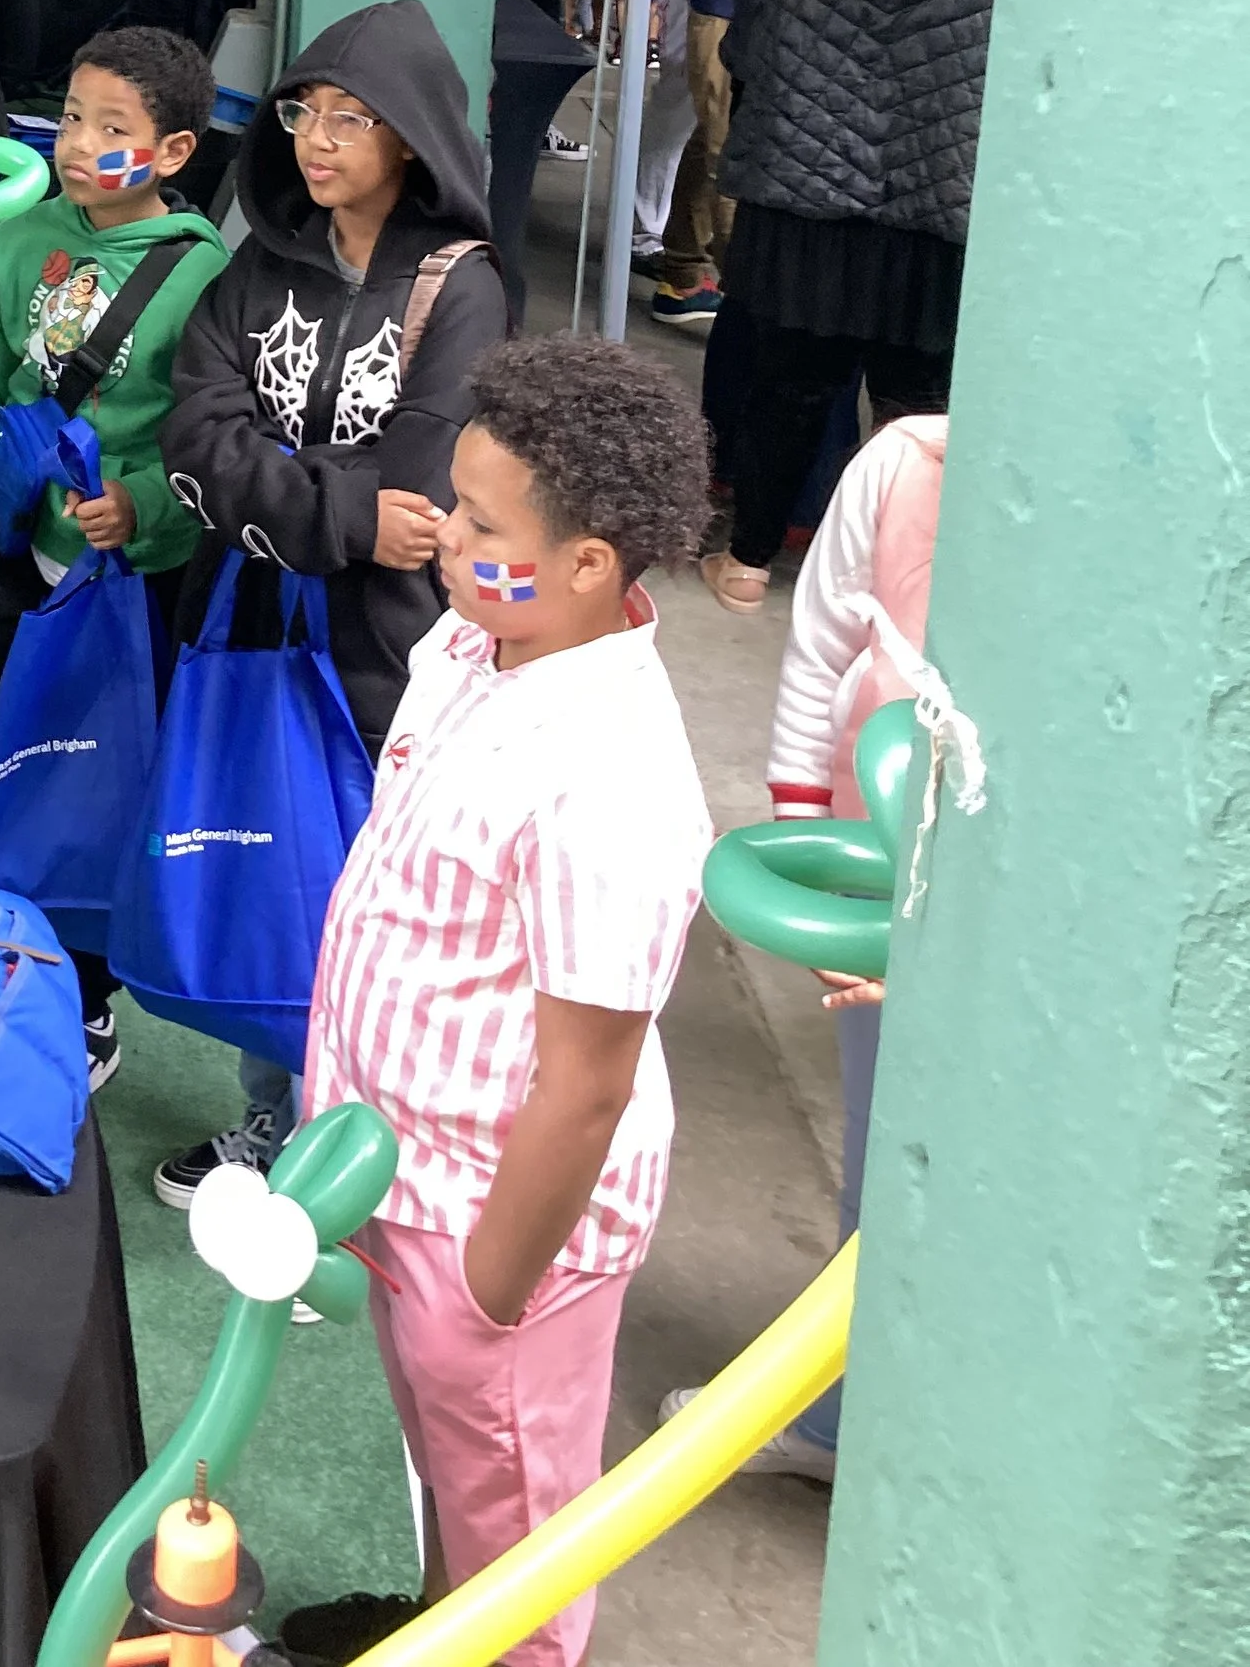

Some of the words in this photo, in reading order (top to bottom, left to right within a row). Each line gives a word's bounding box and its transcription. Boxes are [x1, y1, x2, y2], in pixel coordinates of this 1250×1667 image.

[12, 740, 51, 762] General
[52, 738, 97, 753] Brigham
[192, 828, 231, 841] General
